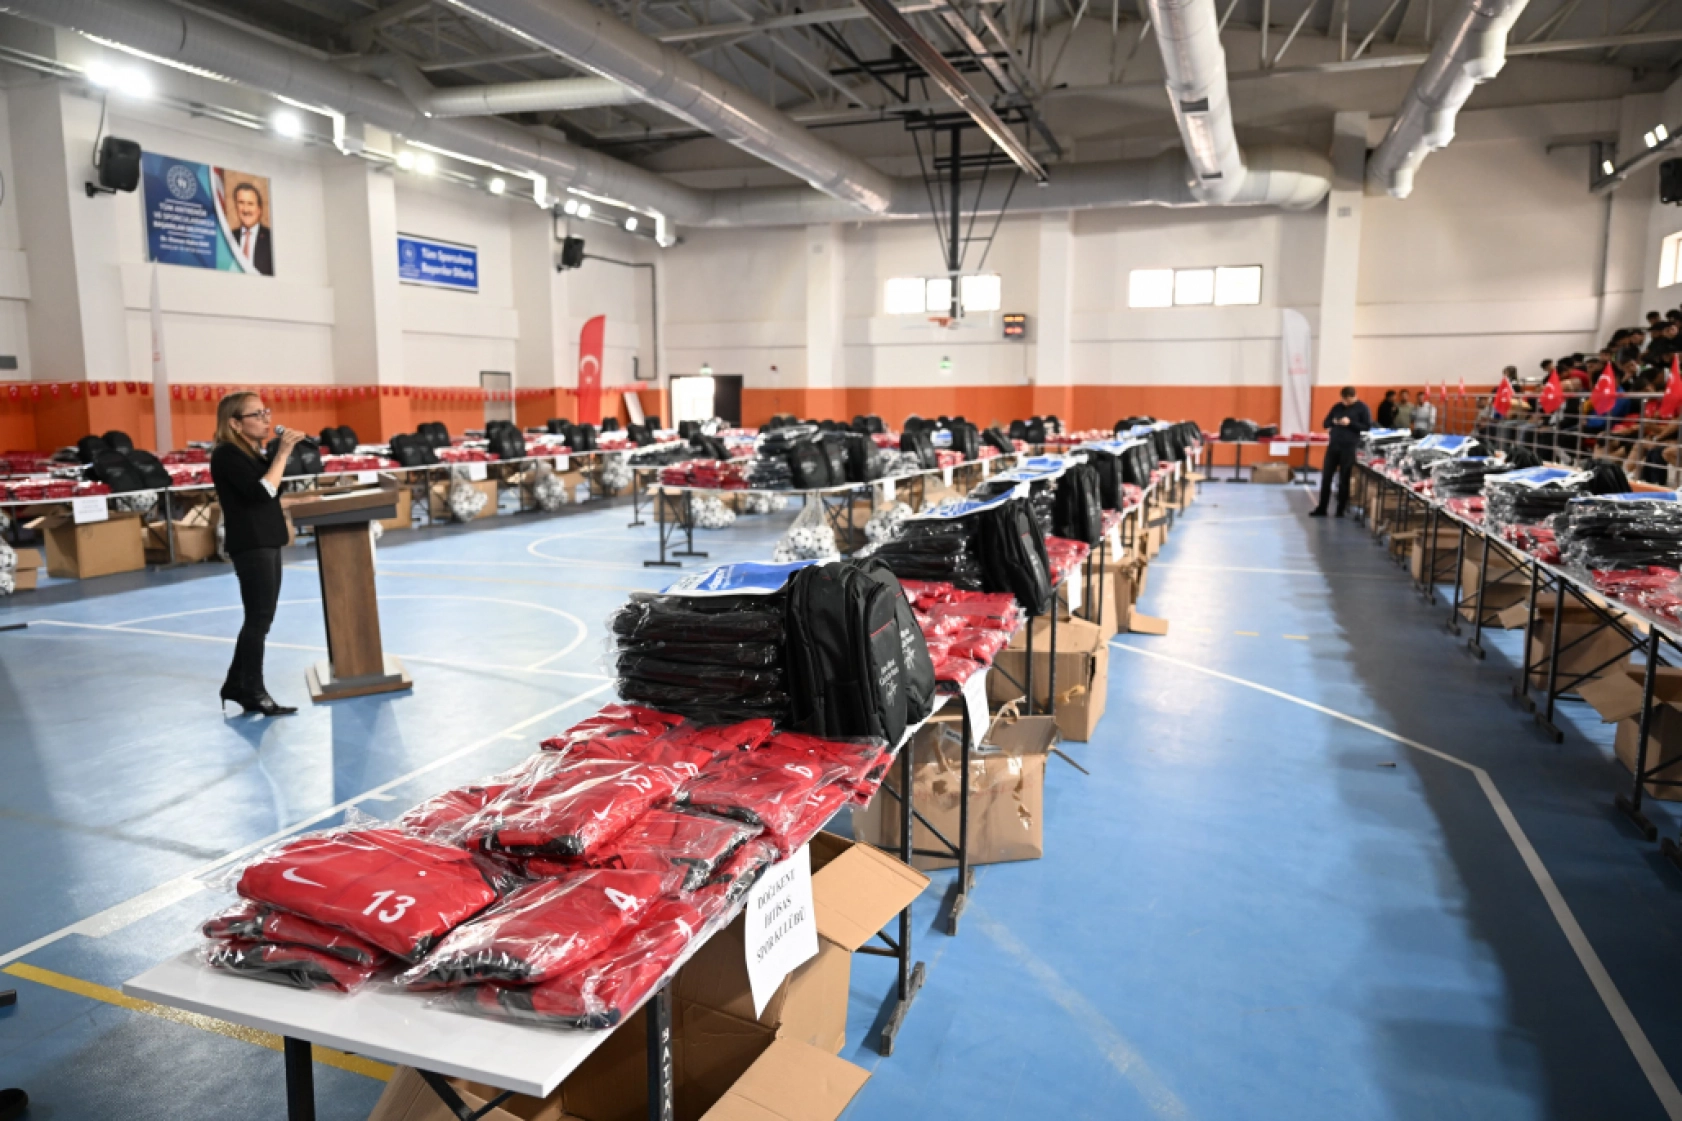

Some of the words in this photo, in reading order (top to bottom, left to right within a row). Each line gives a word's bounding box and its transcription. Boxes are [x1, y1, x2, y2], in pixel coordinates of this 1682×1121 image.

[362, 890, 416, 923] 13
[604, 886, 639, 913] 4
[757, 935, 774, 963] SPOR
